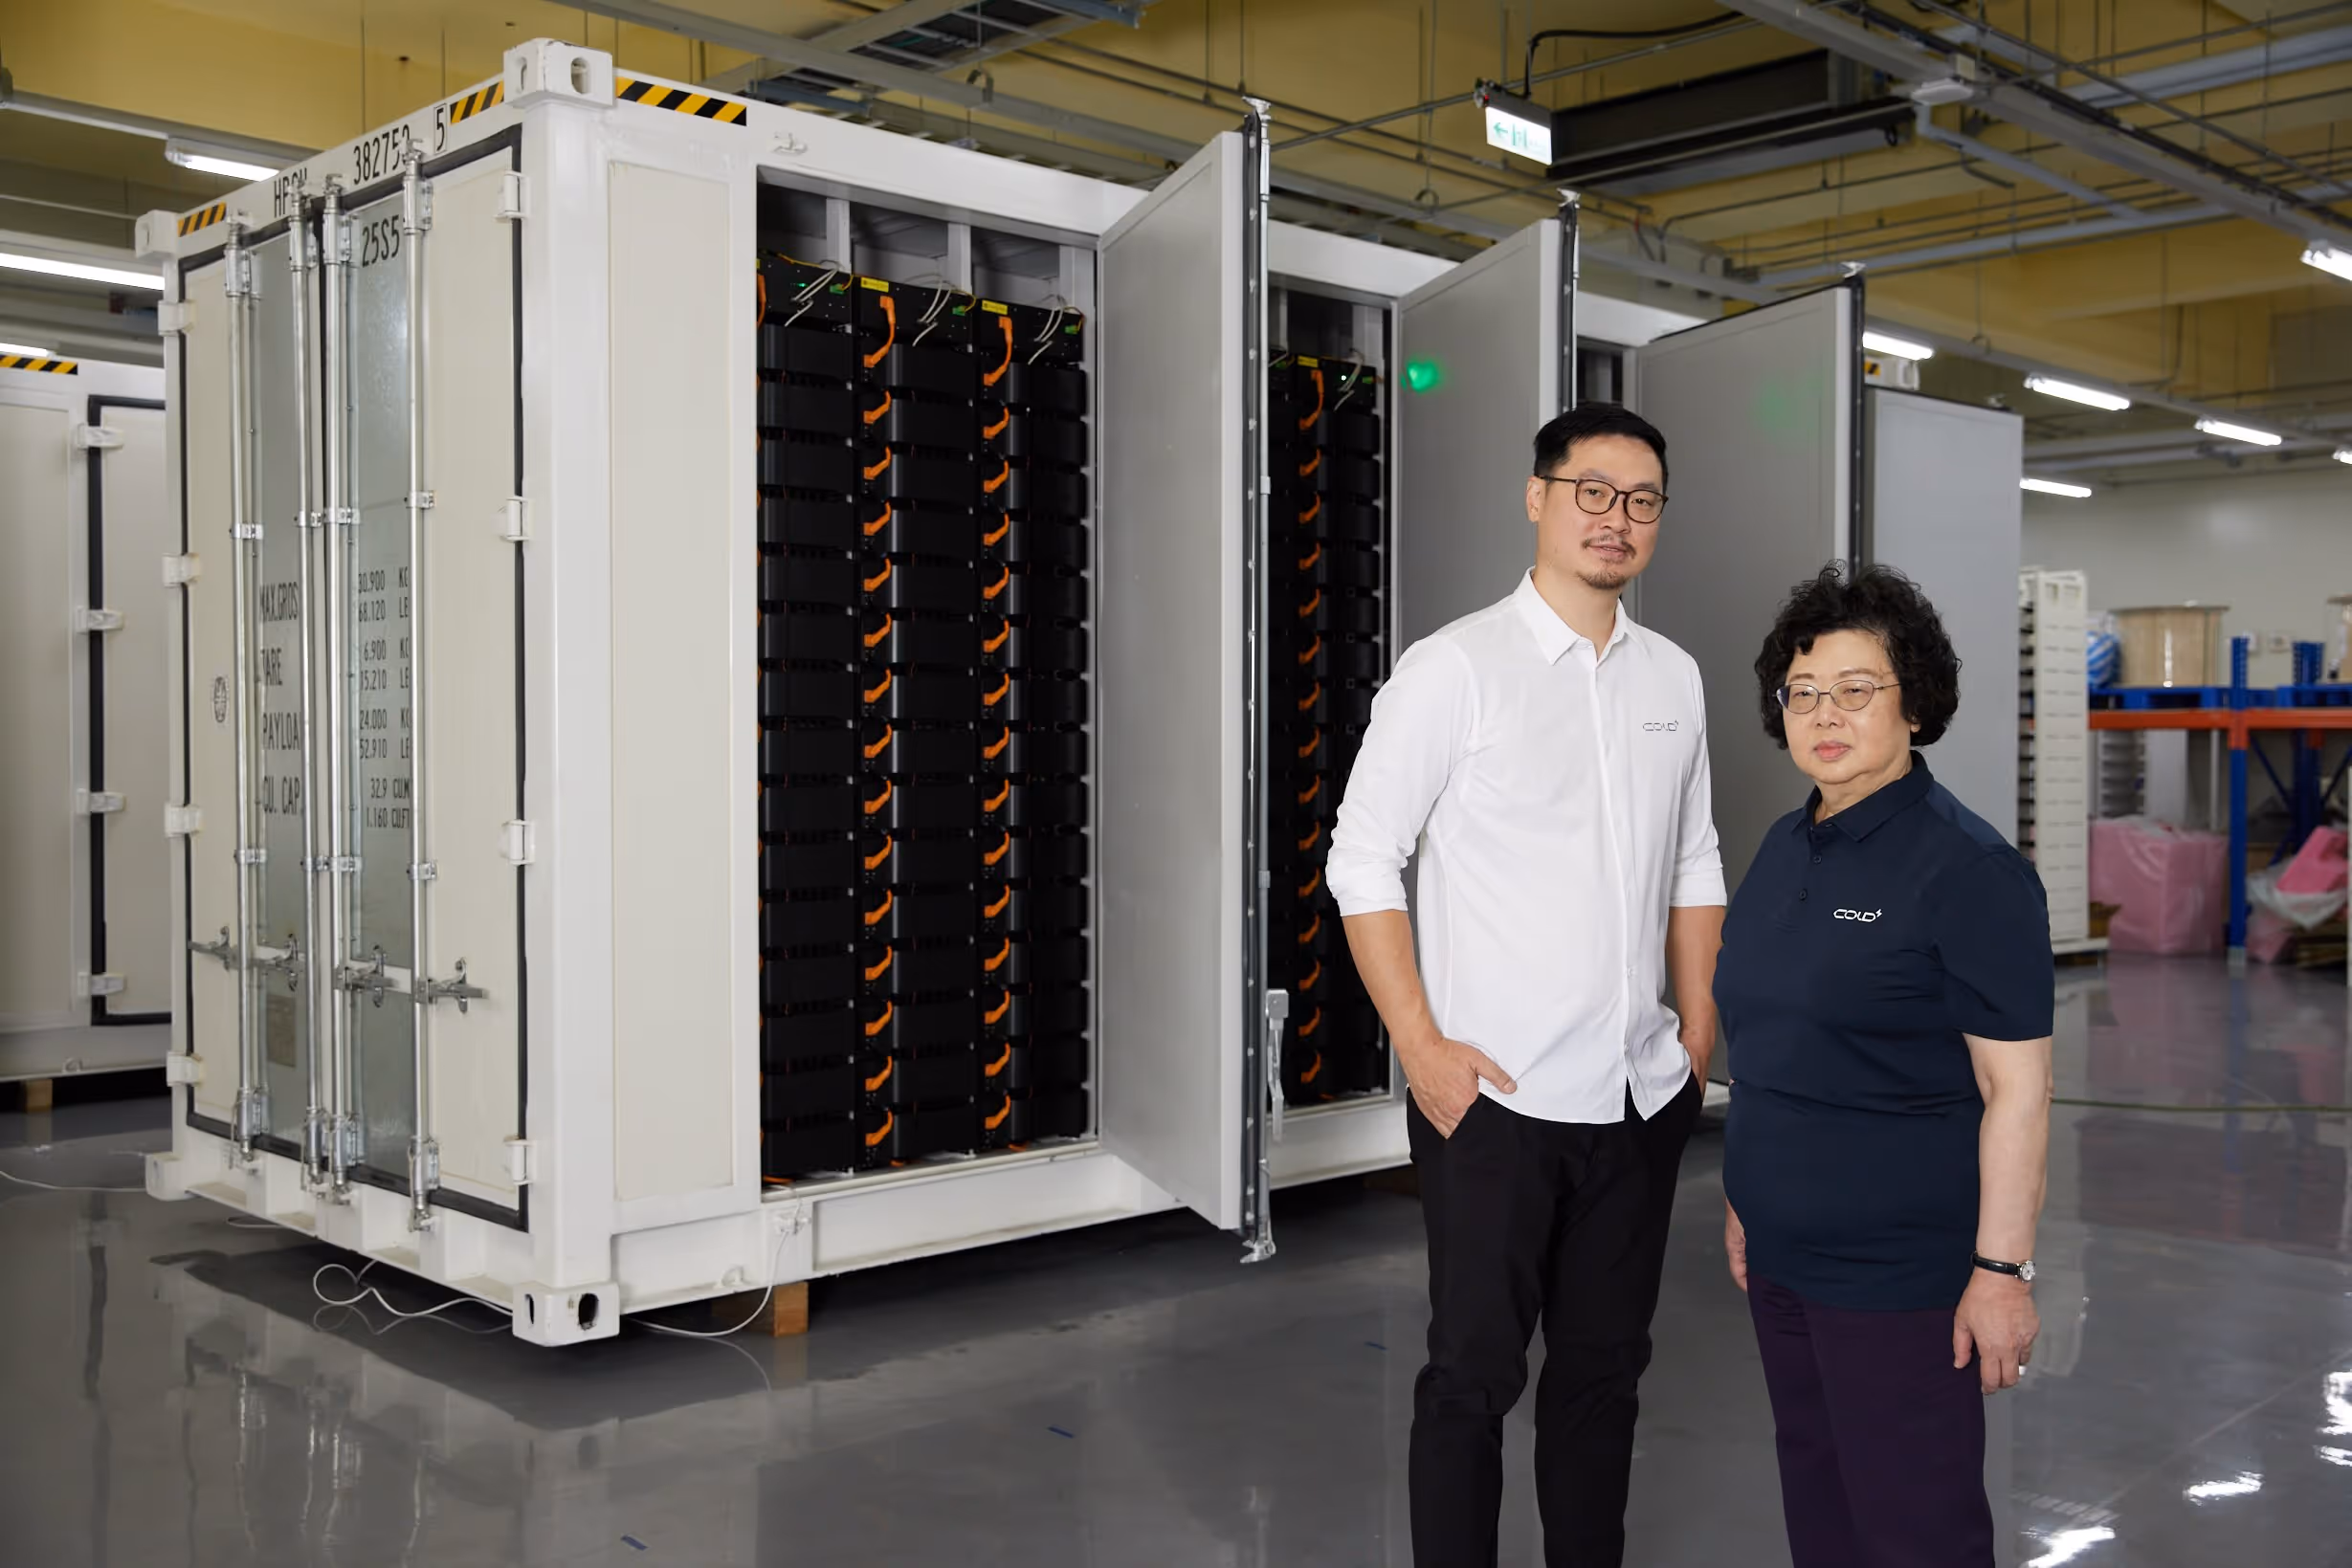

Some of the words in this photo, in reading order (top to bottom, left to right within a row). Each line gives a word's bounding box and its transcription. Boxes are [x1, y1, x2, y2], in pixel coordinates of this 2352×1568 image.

[436, 107, 445, 151] 5
[362, 215, 400, 268] 25S5
[259, 582, 299, 622] MAX.GROS
[261, 648, 282, 686] TARE
[263, 712, 301, 750] PAYLOA
[1642, 720, 1678, 731] COLD
[1833, 908, 1876, 922] COLD
